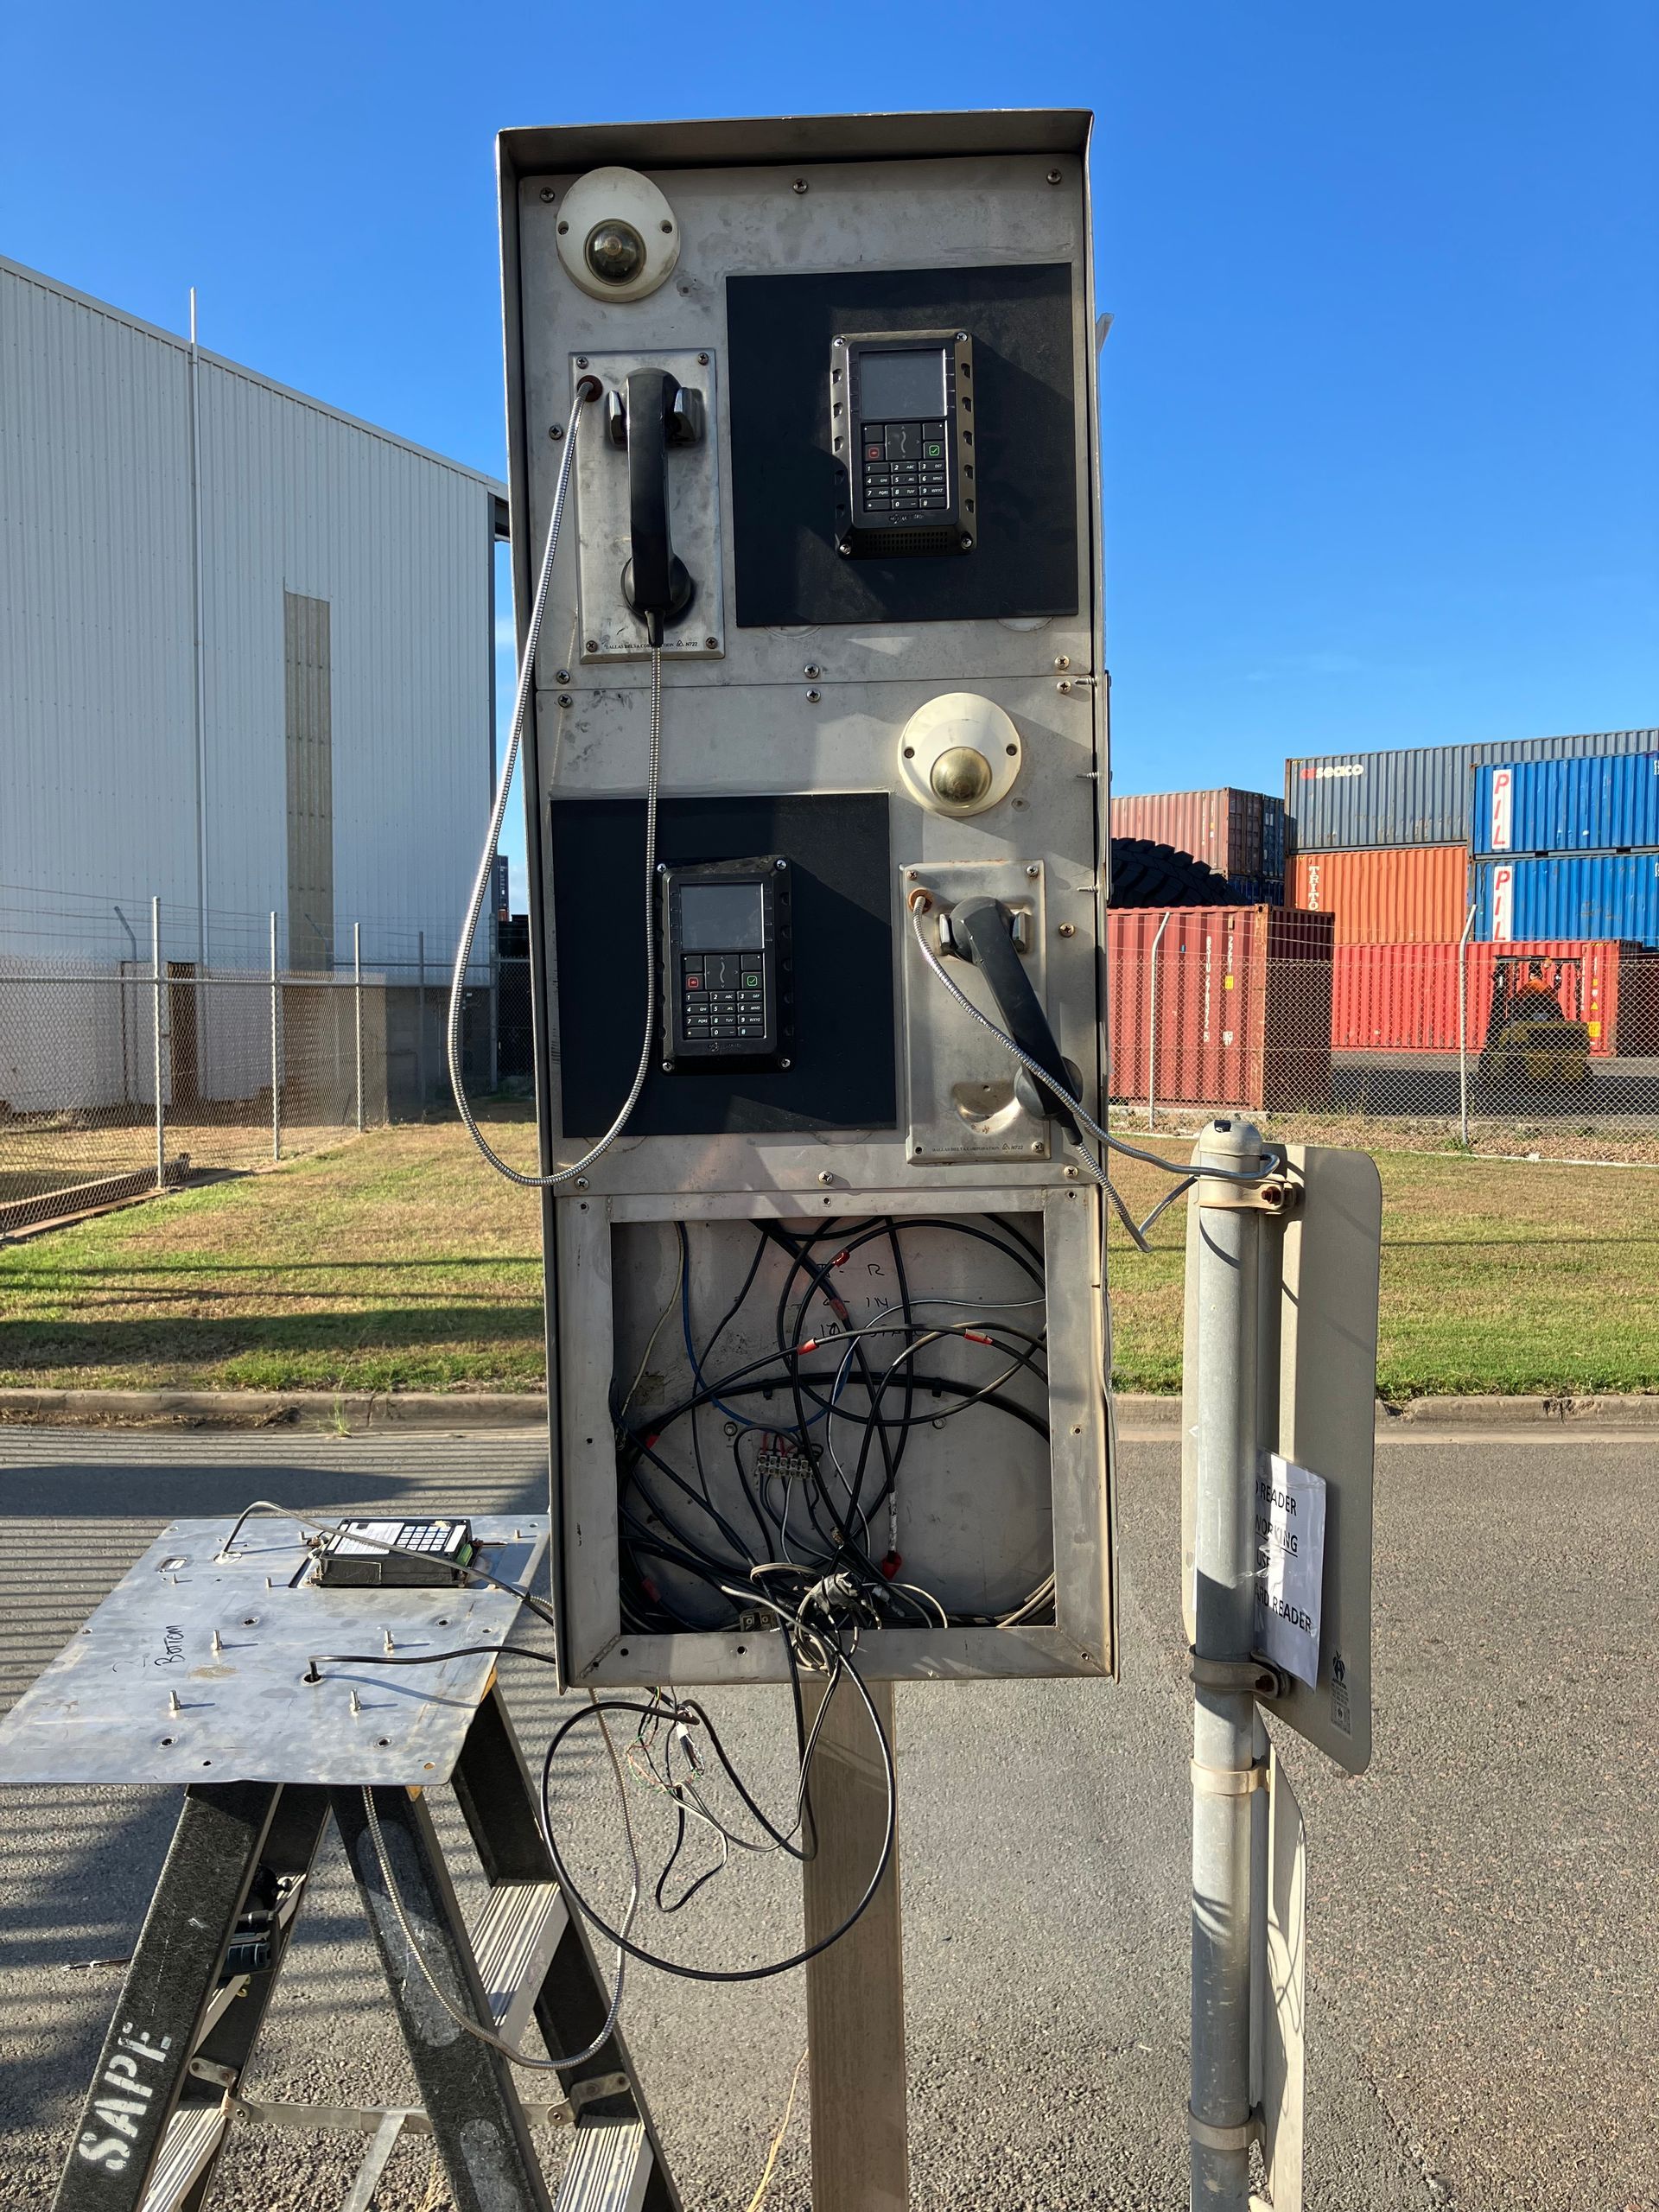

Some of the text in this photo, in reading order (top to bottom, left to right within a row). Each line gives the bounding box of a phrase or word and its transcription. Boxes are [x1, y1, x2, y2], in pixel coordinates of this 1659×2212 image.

[1494, 773, 1510, 845] PIL
[1307, 866, 1320, 912] TRITO
[1495, 870, 1510, 941] PIL
[867, 1263, 885, 1276] R
[1260, 1484, 1297, 1516] READER
[1255, 1583, 1313, 1634] ARD READER
